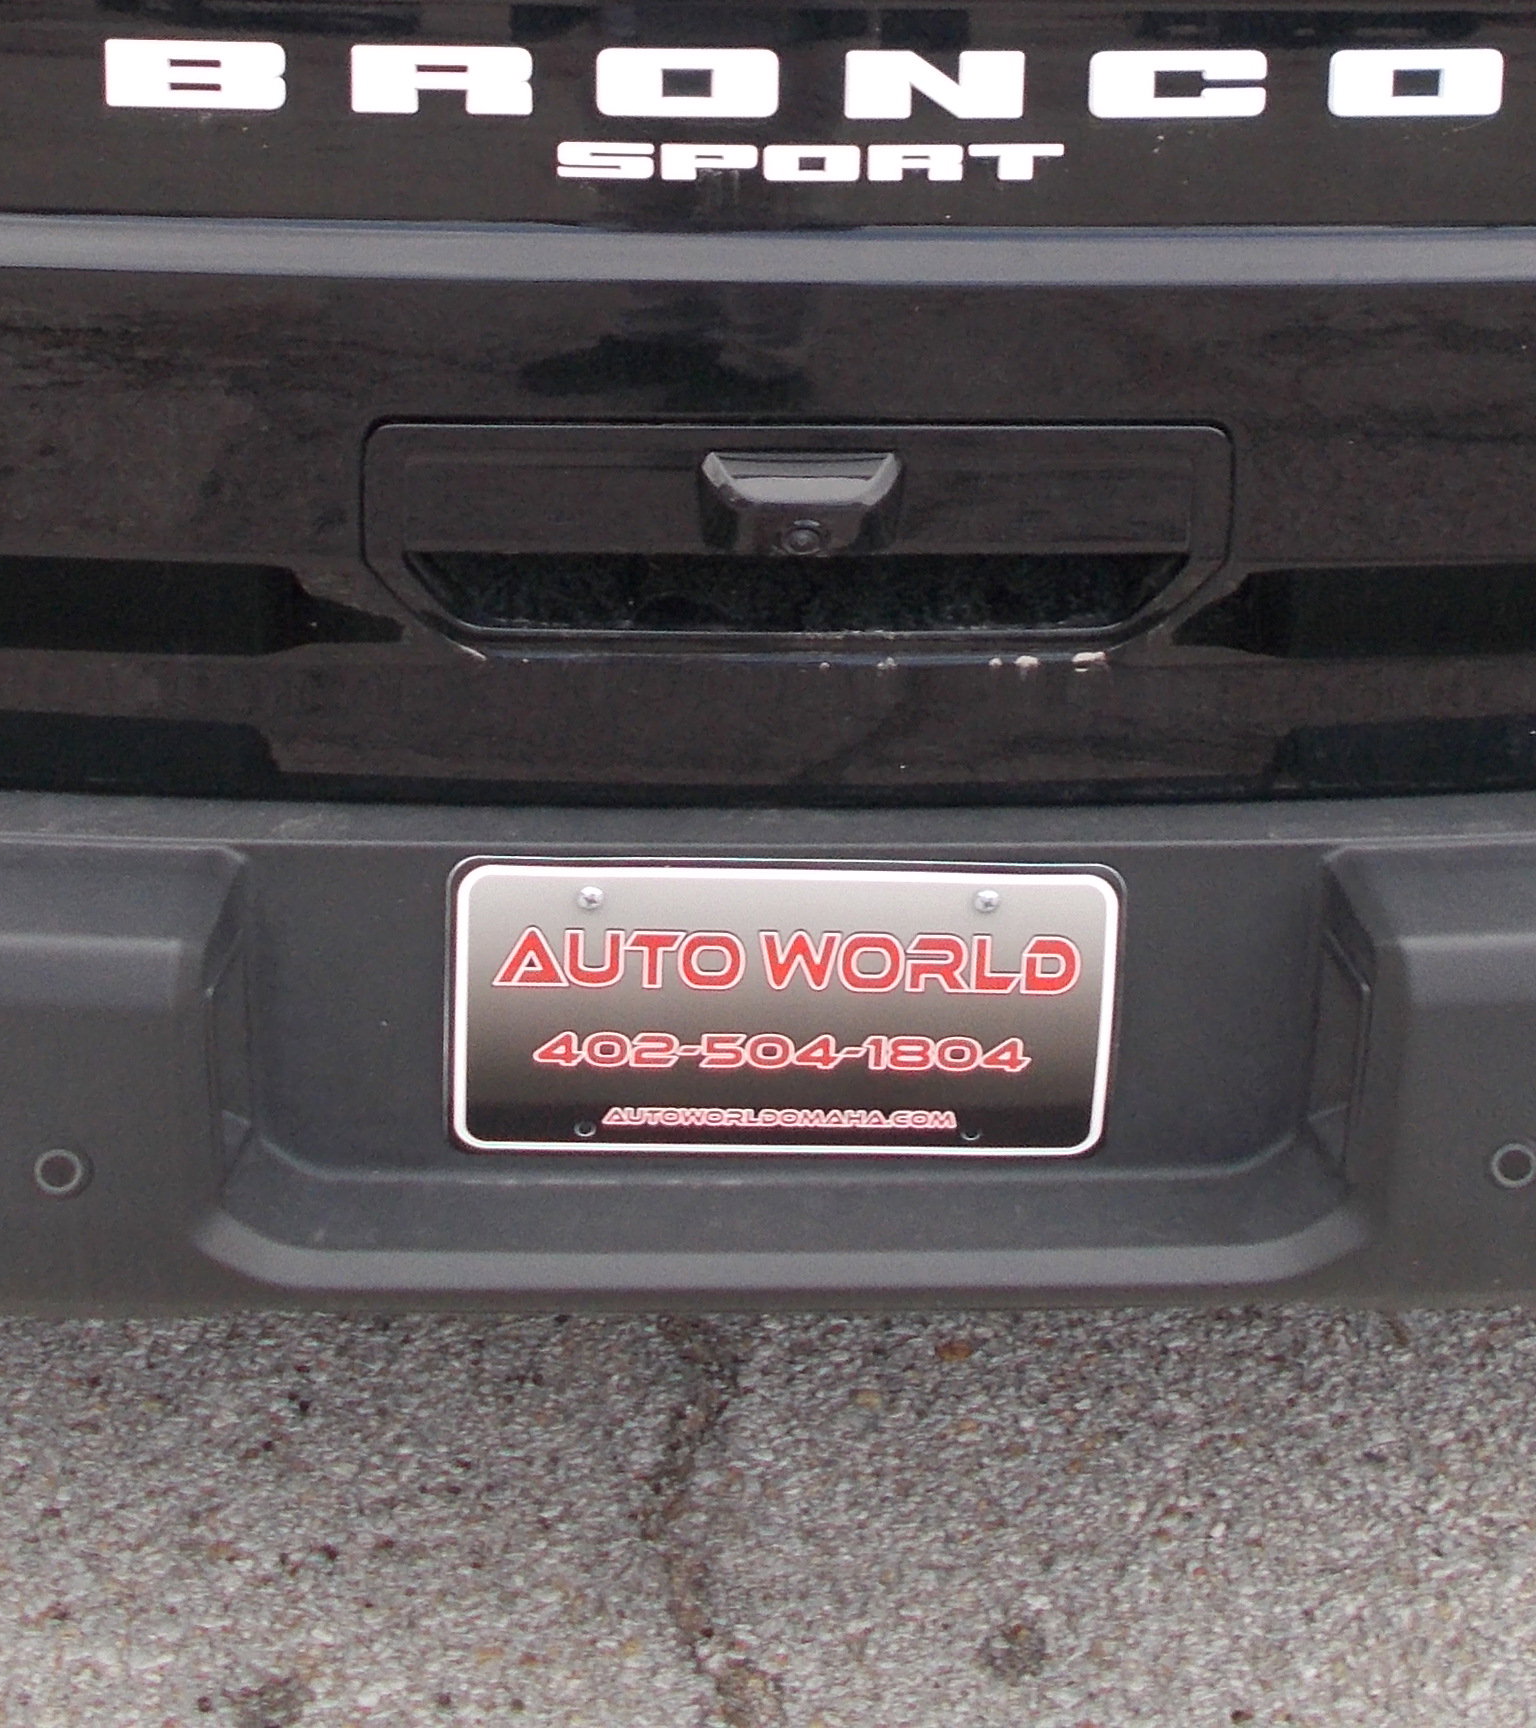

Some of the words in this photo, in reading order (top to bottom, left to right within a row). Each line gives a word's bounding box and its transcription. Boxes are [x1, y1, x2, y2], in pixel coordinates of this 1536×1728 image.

[104, 38, 1505, 120] BRONCO
[555, 140, 1065, 183] SPORT
[492, 925, 747, 990] AUTO
[758, 928, 1082, 995] WORLD
[532, 1030, 1031, 1073] 402-504-1804
[601, 1105, 957, 1130] AUTOWORLDOMAHA.COM
